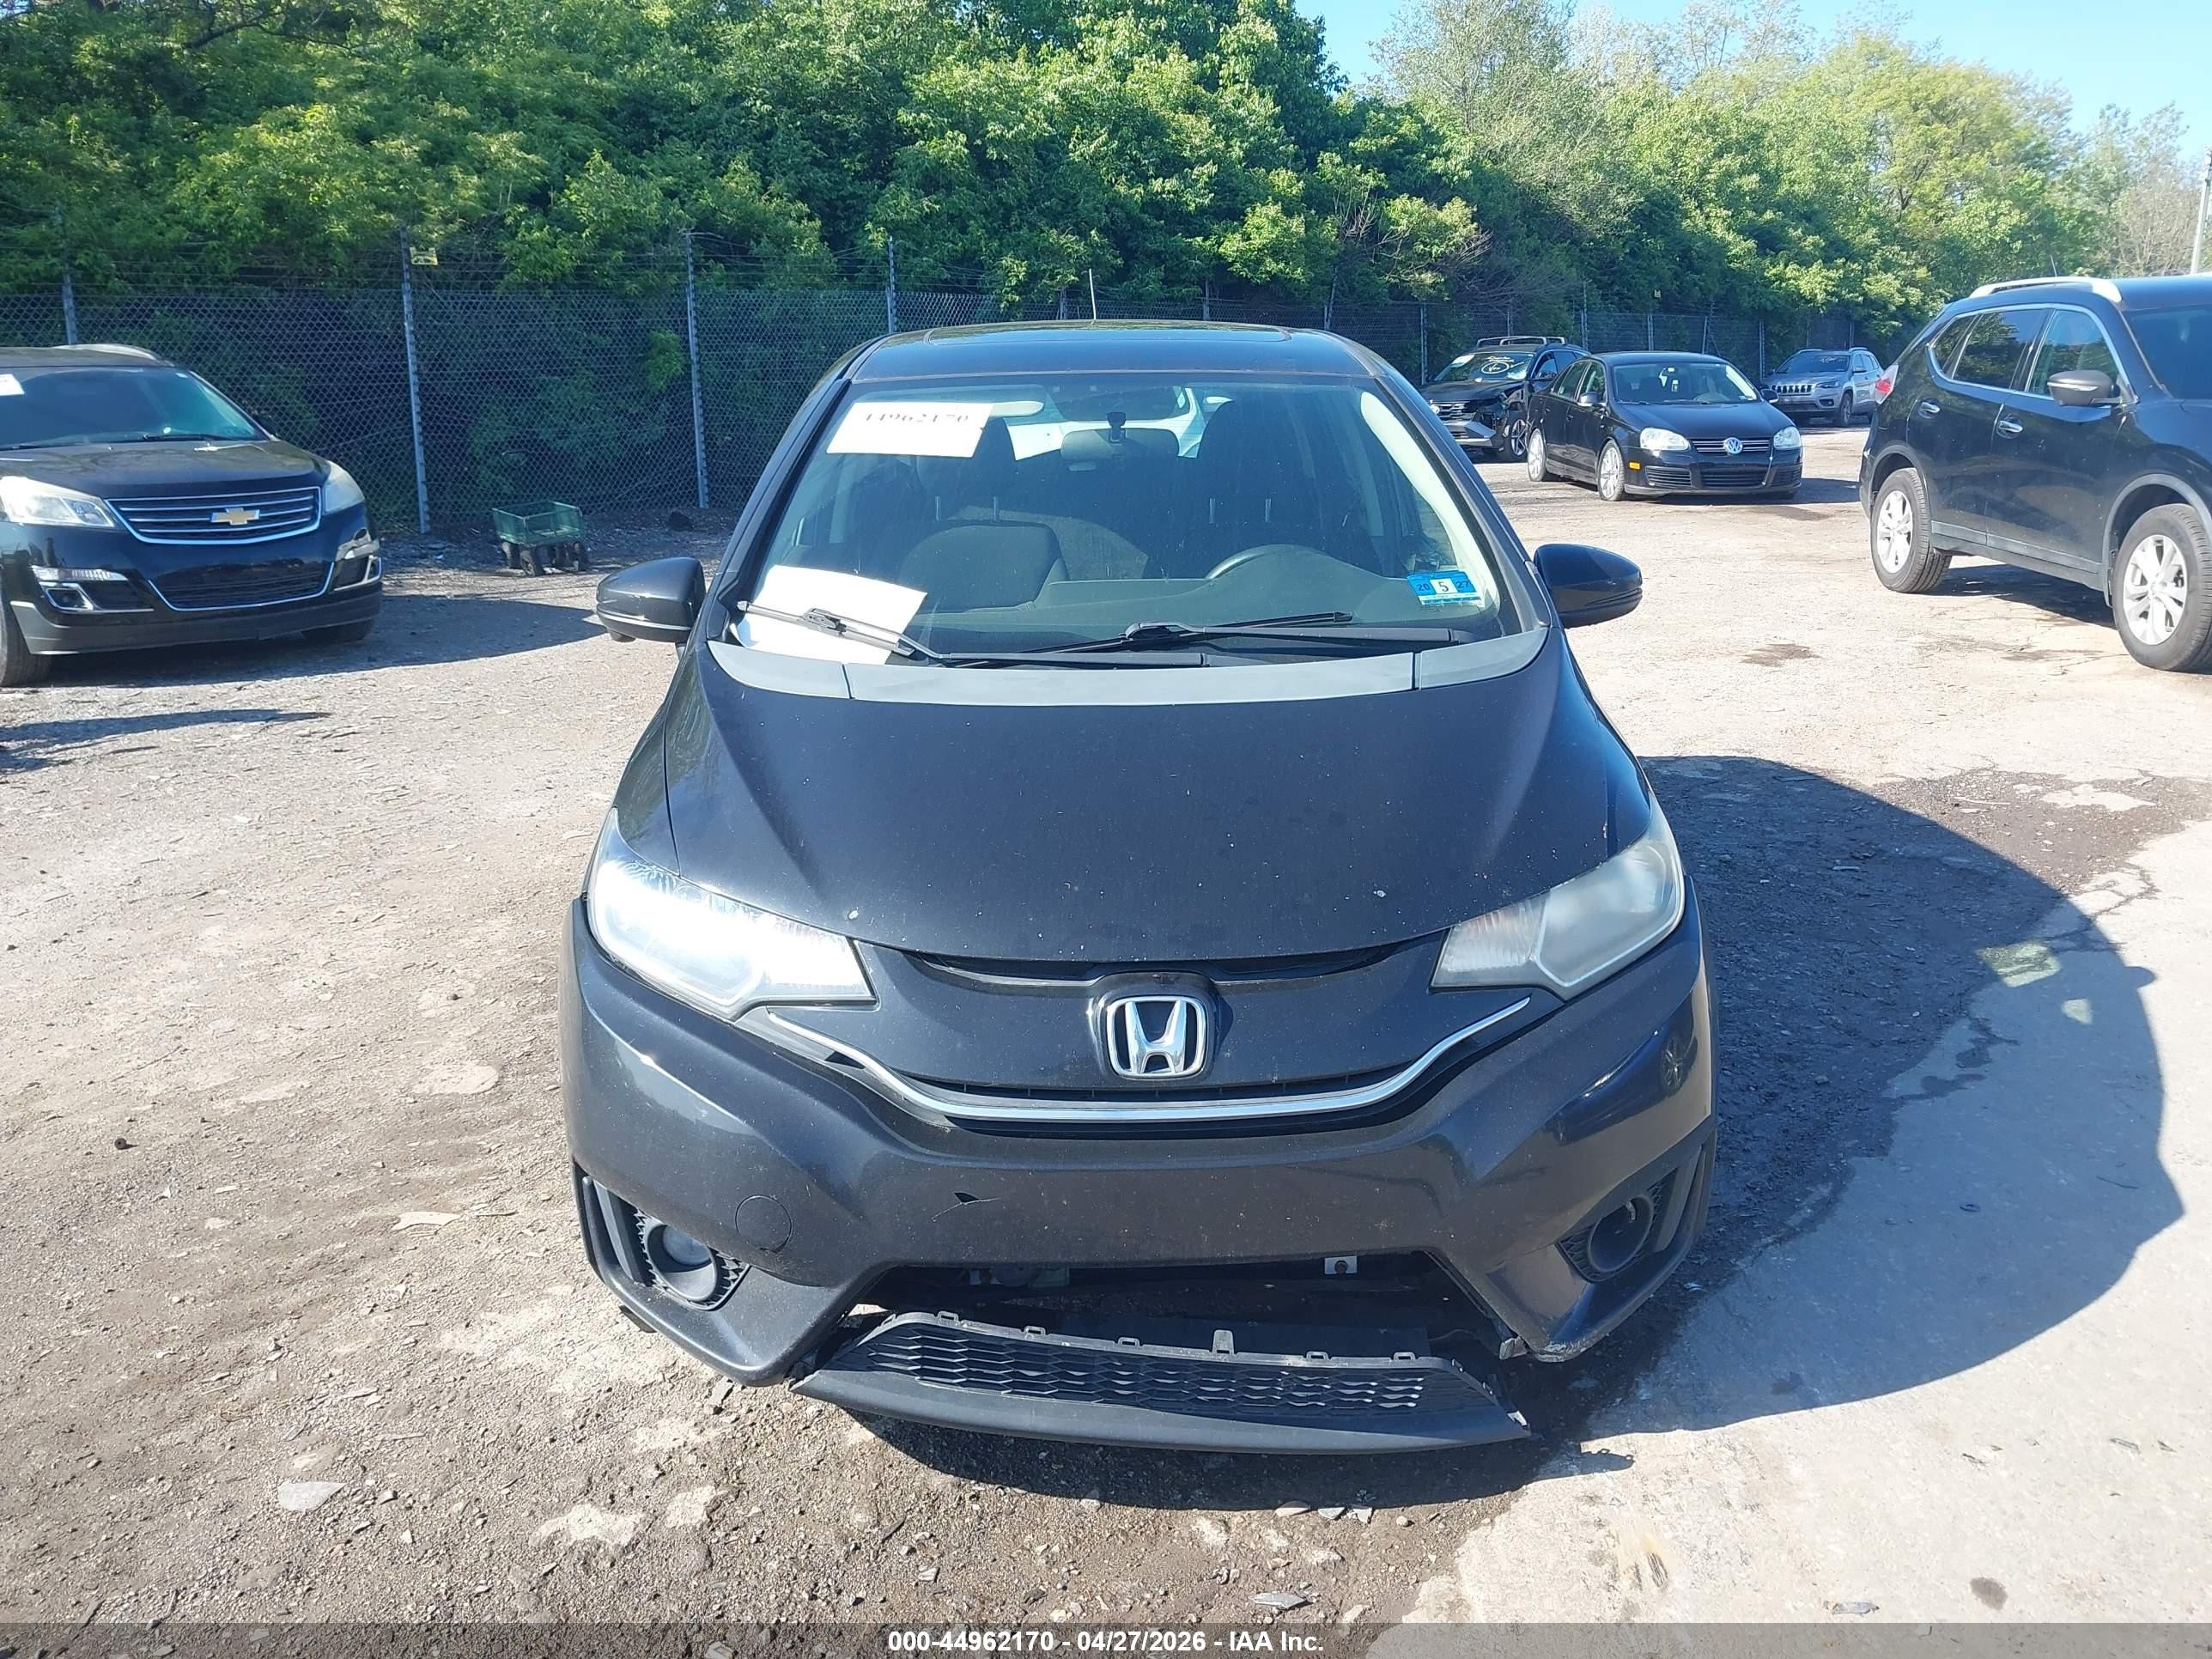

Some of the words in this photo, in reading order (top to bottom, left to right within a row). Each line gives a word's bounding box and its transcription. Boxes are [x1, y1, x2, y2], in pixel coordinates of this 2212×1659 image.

[1415, 583, 1431, 592] 20
[1437, 580, 1449, 592] 5
[1455, 580, 1469, 589] 27
